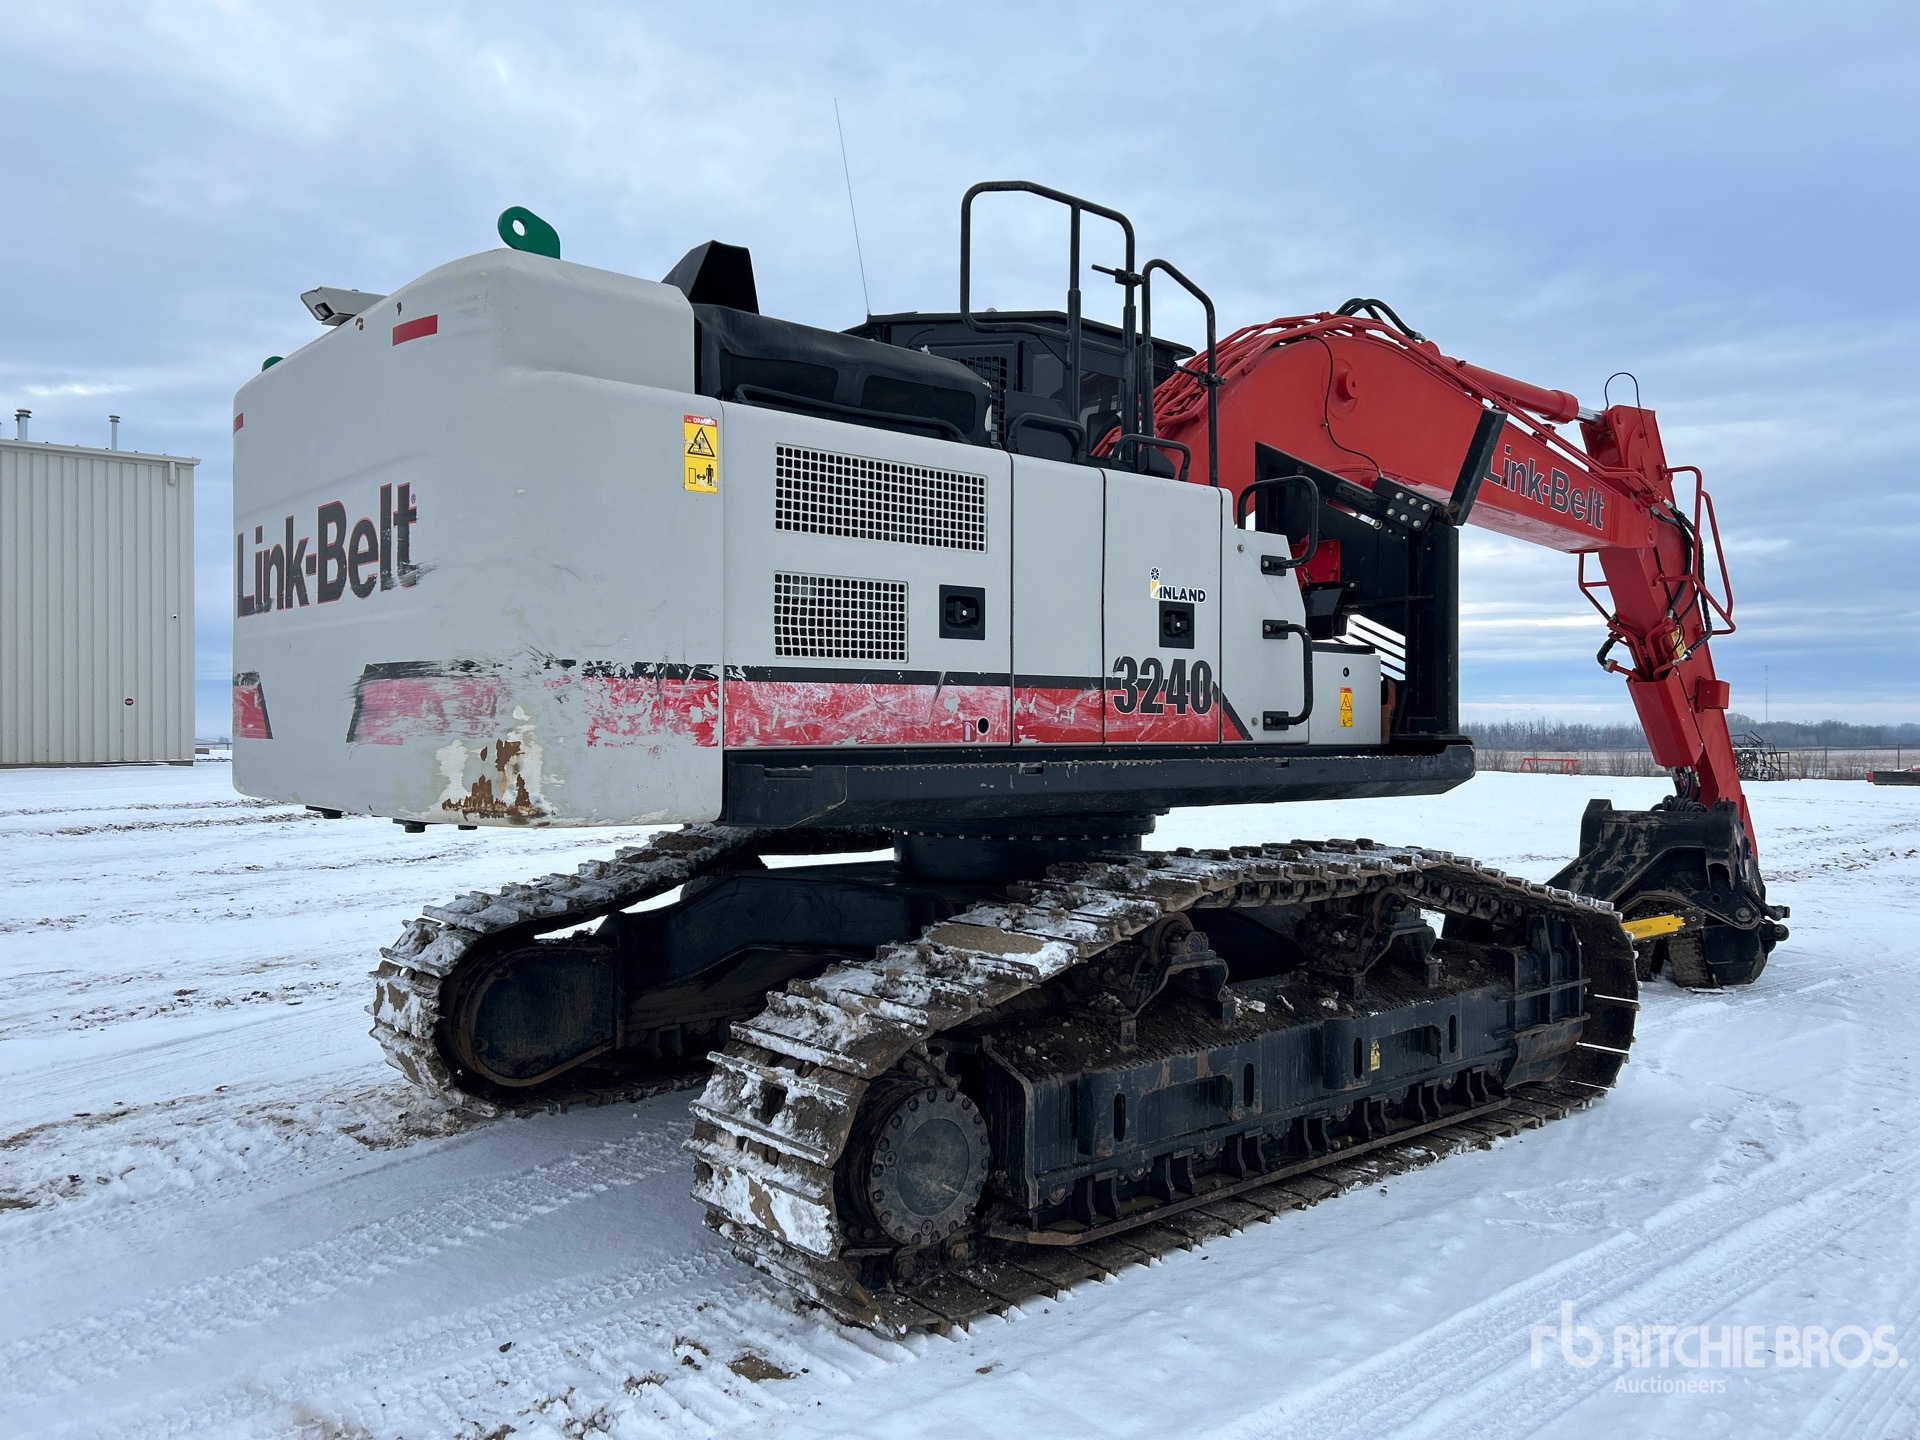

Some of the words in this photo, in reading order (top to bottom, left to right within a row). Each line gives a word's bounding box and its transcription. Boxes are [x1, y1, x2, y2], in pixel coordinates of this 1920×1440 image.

[692, 417, 716, 427] DANR
[1483, 443, 1605, 531] Link-Belt
[237, 482, 417, 618] Link-Belt
[1158, 585, 1206, 603] INLAND
[1112, 655, 1213, 715] 3240
